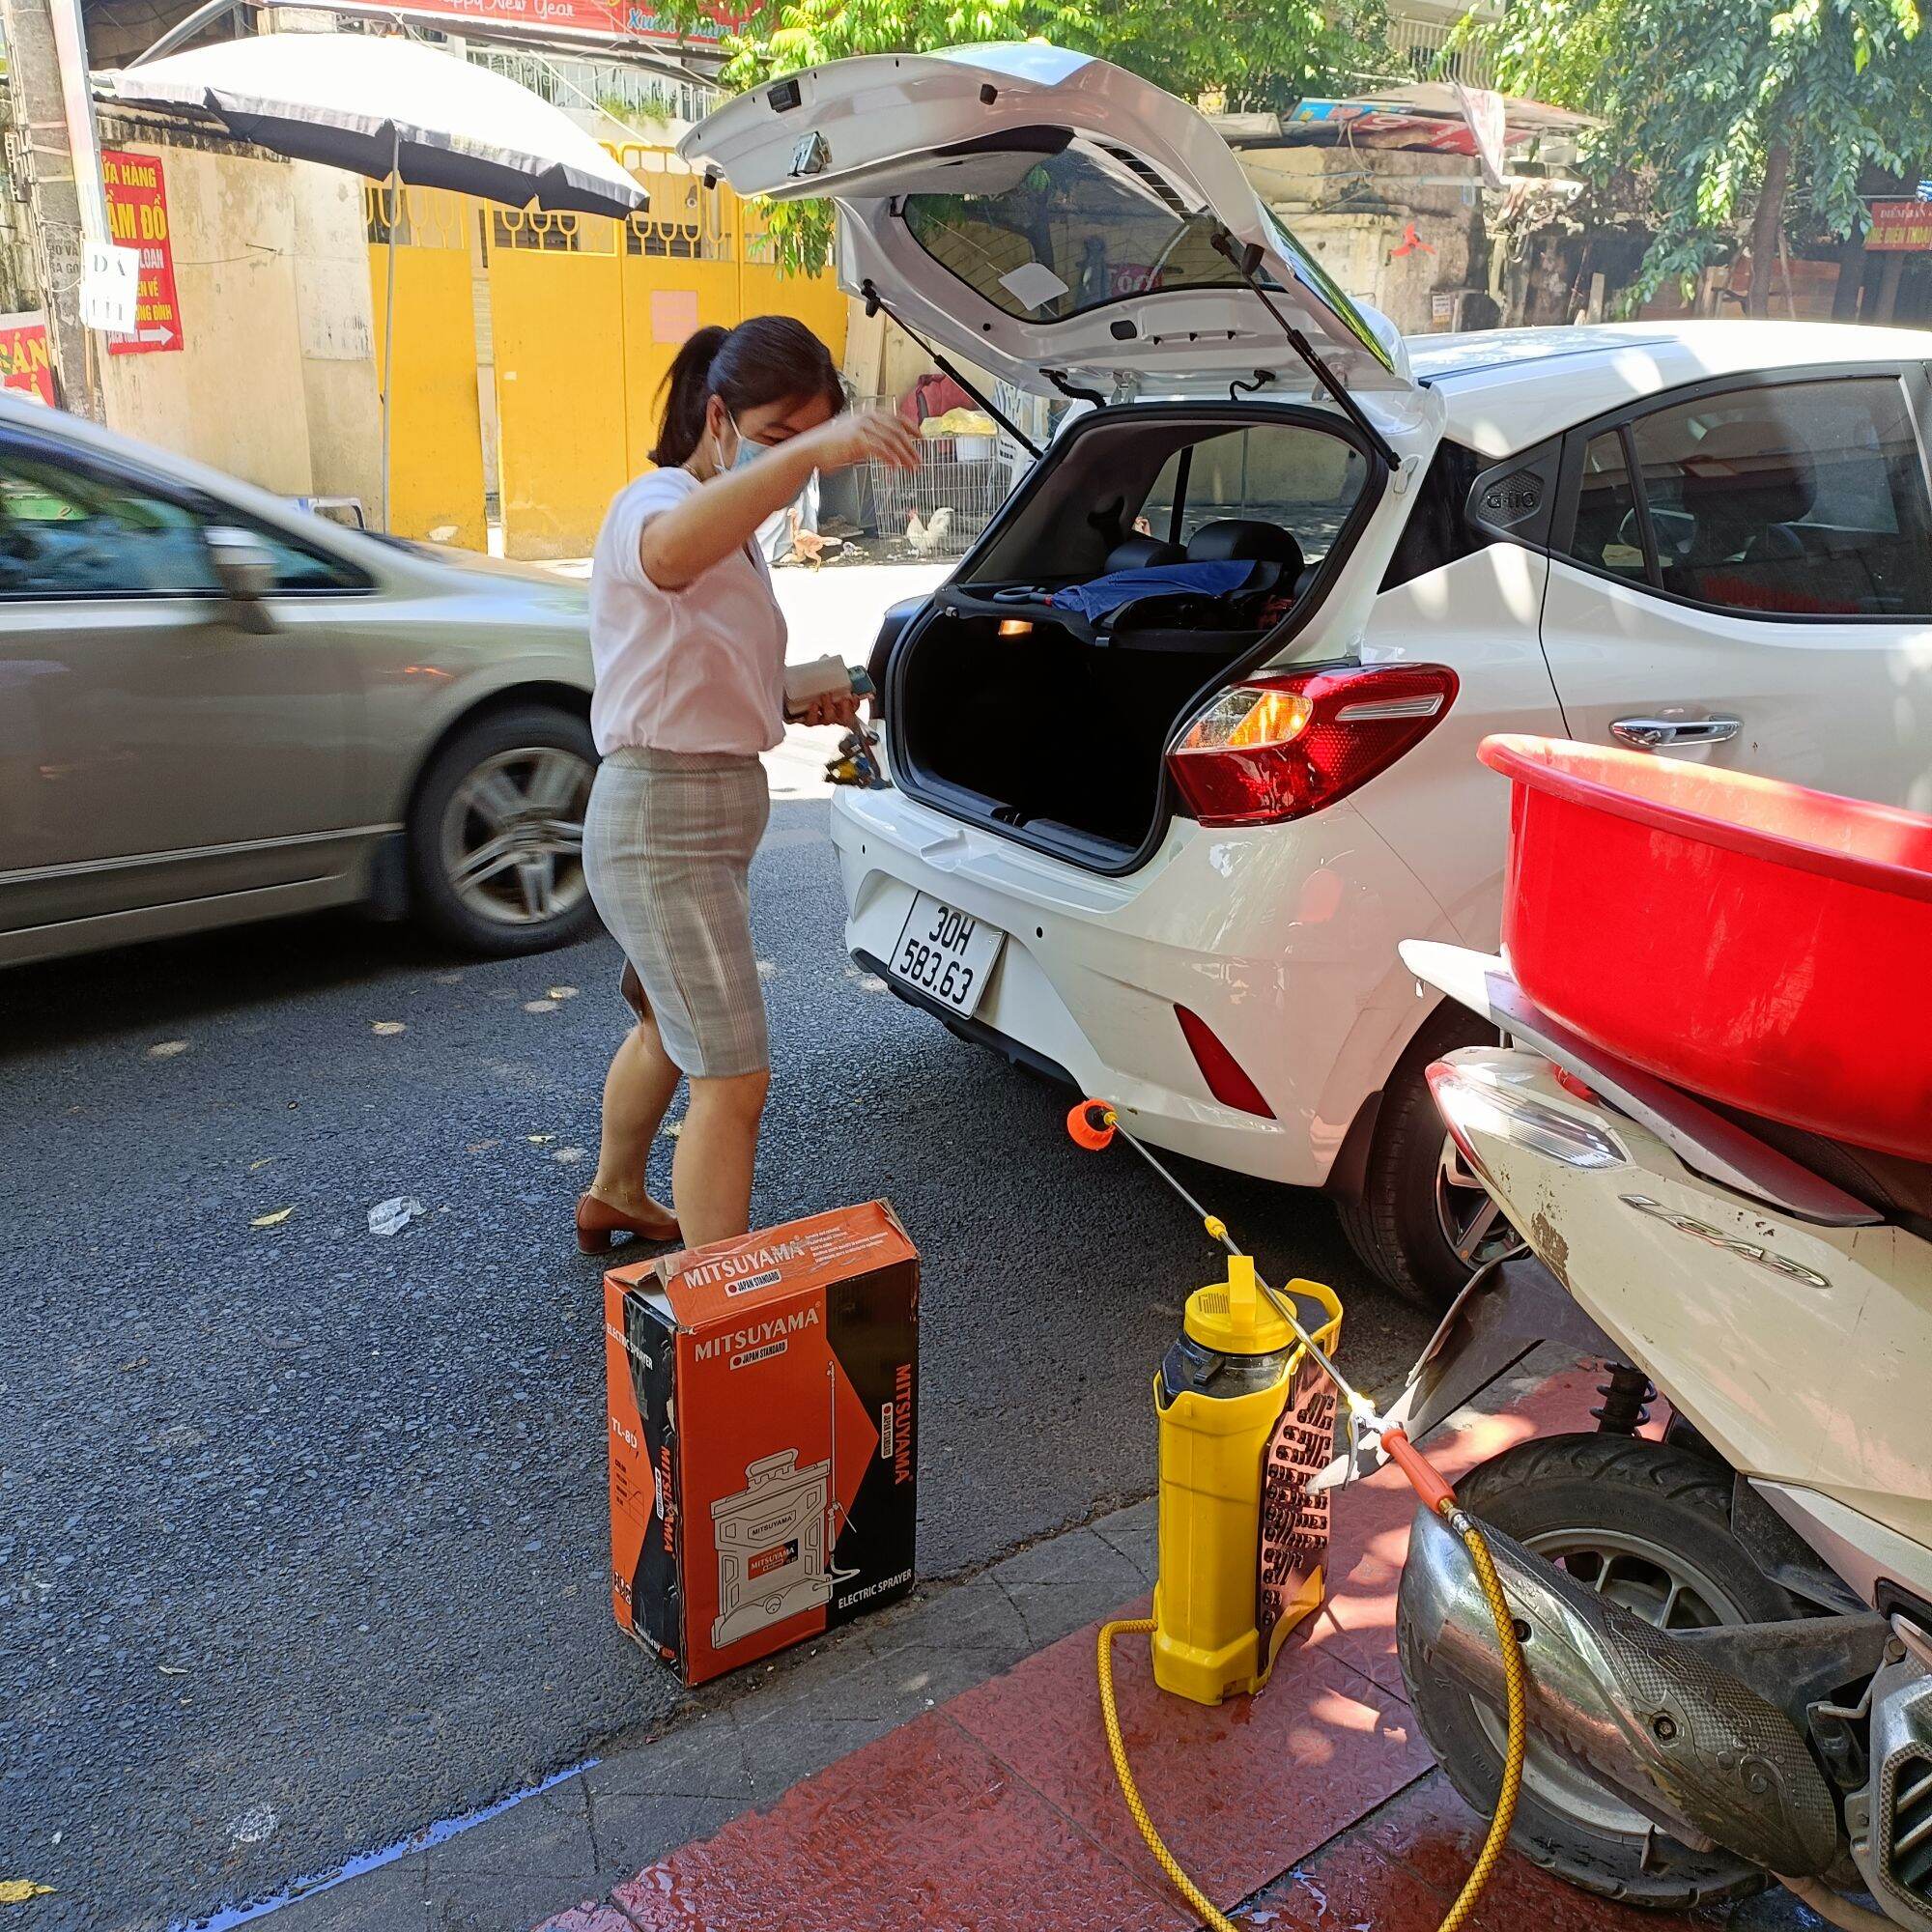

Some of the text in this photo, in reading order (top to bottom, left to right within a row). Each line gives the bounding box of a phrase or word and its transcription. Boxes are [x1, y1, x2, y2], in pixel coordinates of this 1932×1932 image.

[121, 160, 157, 188] HÀNG
[105, 188, 167, 242] ẦM ĐỒ
[928, 906, 976, 956] 30H
[899, 938, 974, 1005] 583.63
[683, 1241, 805, 1290] MITSUYAMA
[737, 1270, 780, 1292] JAPAN STANDARD
[607, 1321, 653, 1371] ELECTRIC SPRAYER
[695, 1307, 819, 1362] MITSUYAMA
[742, 1341, 786, 1364] JAPAN STANDARD
[895, 1363, 911, 1485] MITSUYAMA
[752, 1516, 792, 1536] MITSUYAMA
[751, 1547, 795, 1570] MITSUYAMA
[838, 1569, 912, 1609] ELECTRIC SPRAYER
